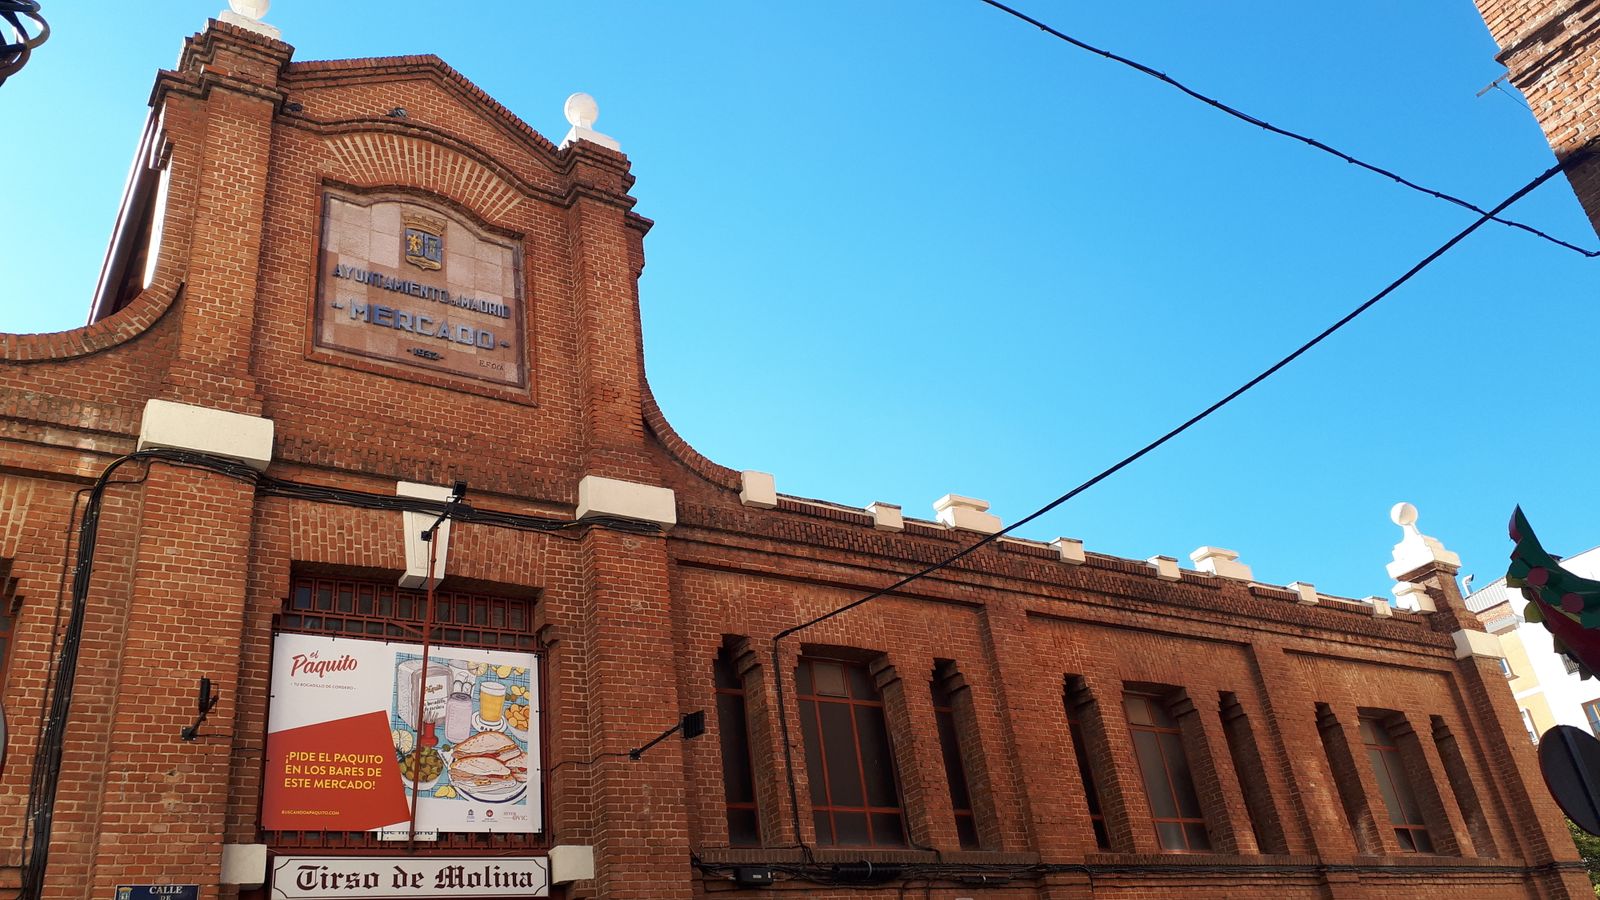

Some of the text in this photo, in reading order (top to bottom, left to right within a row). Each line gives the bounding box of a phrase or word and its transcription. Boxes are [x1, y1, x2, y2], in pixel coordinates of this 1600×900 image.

[332, 263, 449, 304] AYUNTAMIENTO
[461, 296, 512, 319] MADRID
[350, 300, 495, 350] MERCADO
[309, 650, 319, 659] el
[290, 654, 358, 678] Paquito
[285, 751, 383, 765] ¡PIDE EL PAQUITO
[285, 764, 382, 777] EN LOS BARES DE
[284, 777, 376, 790] ESTE MERCADO!
[296, 864, 534, 891] Tirso de Molina
[149, 886, 183, 894] CALLE
